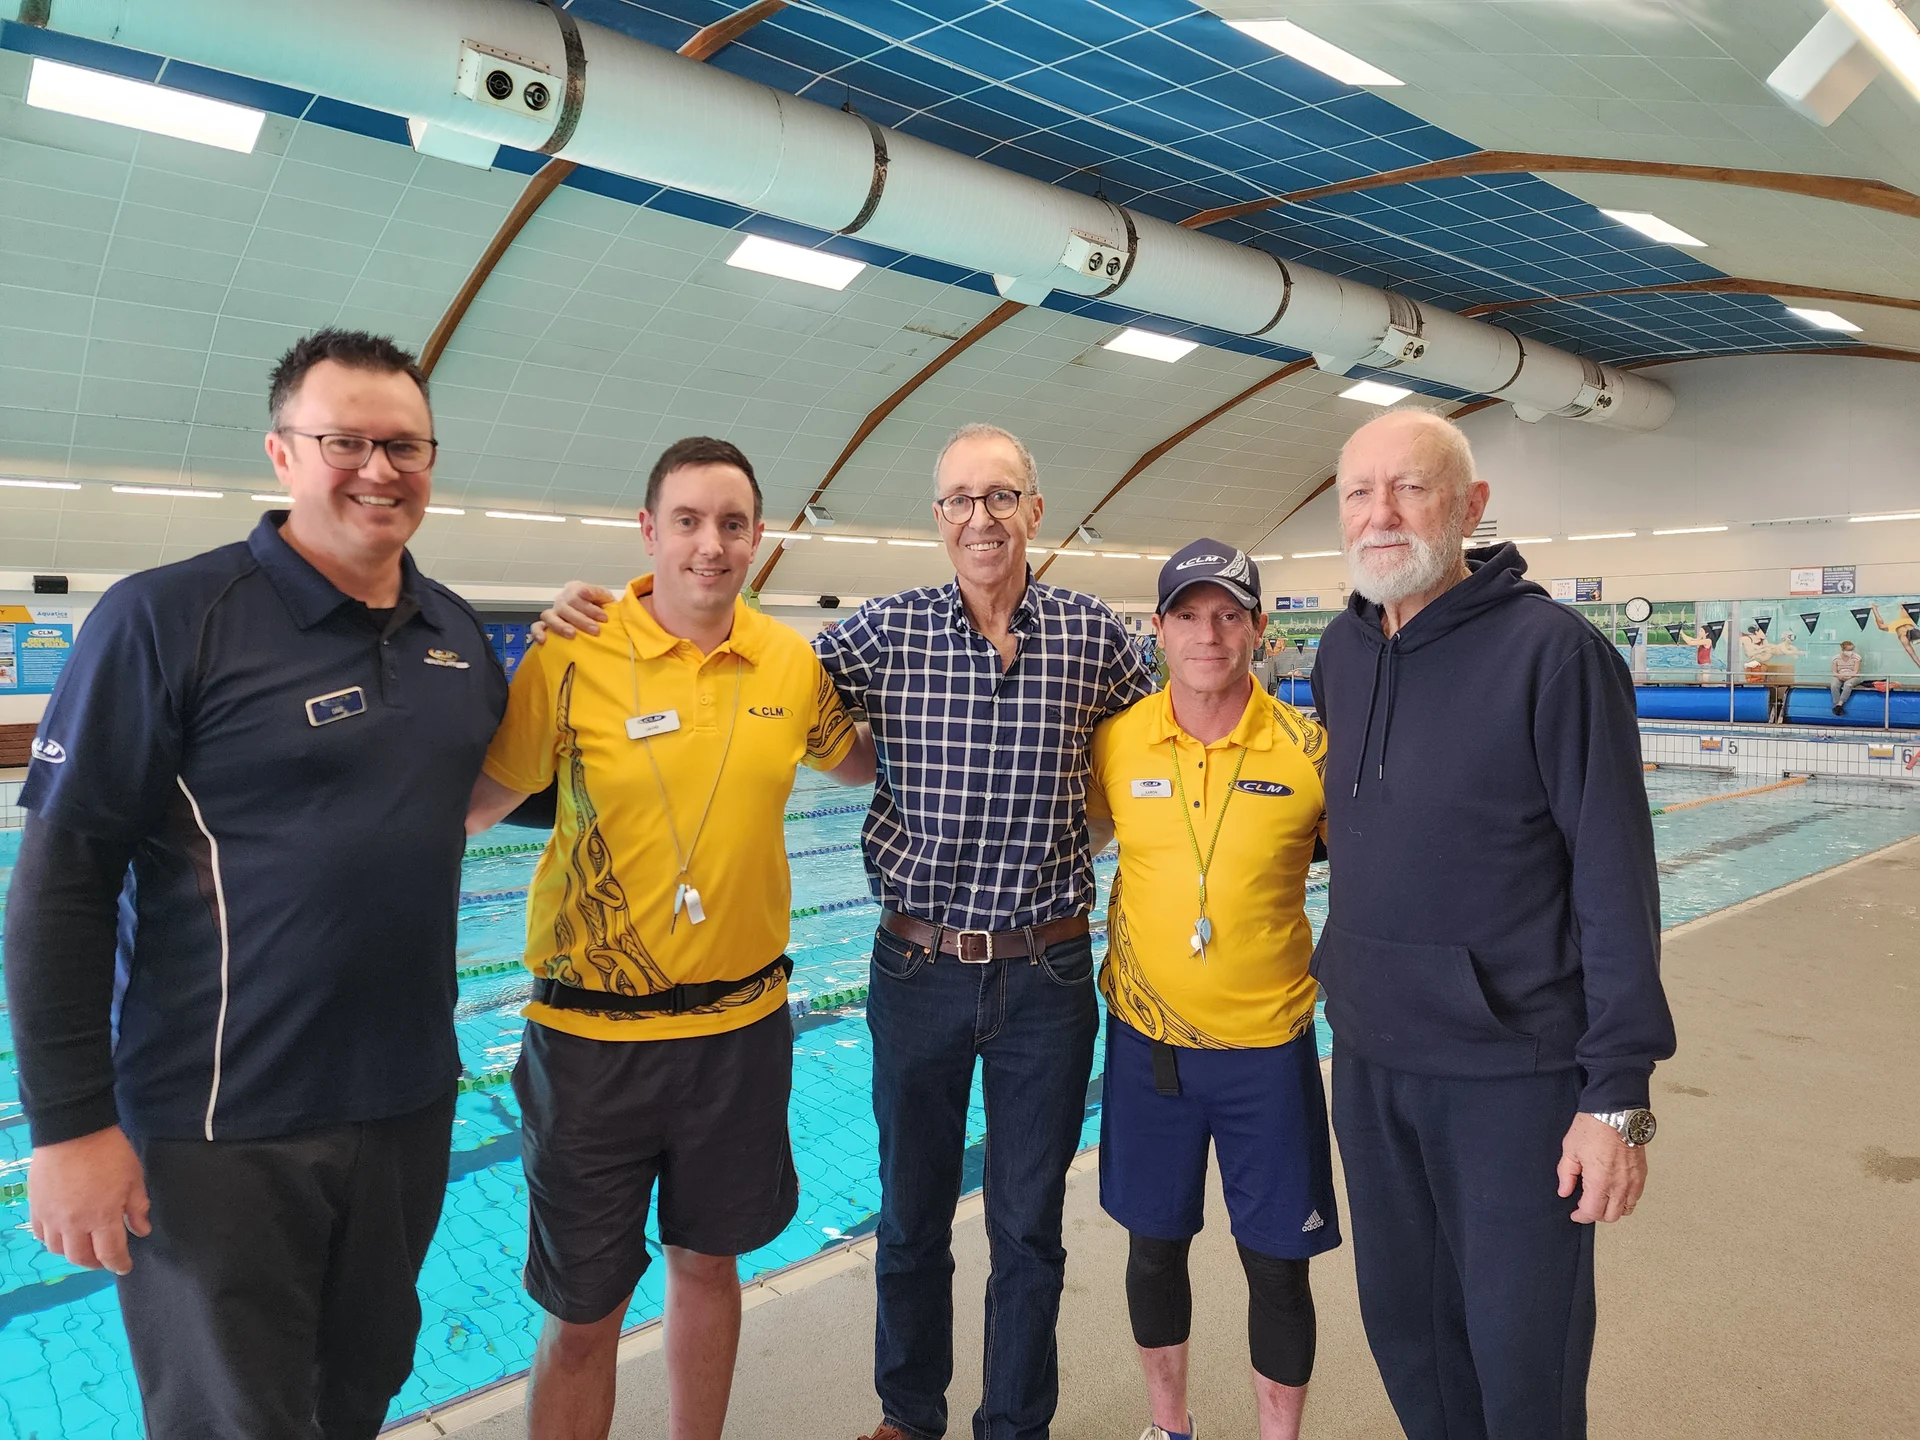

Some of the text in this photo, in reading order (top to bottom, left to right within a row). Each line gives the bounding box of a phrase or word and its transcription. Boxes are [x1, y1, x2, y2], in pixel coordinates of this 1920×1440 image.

[1186, 557, 1219, 565] CLM
[762, 706, 784, 716] CLM
[1729, 741, 1738, 754] 5
[1903, 748, 1912, 763] 6
[1243, 782, 1284, 793] CLM
[1302, 1219, 1325, 1232] adidas
